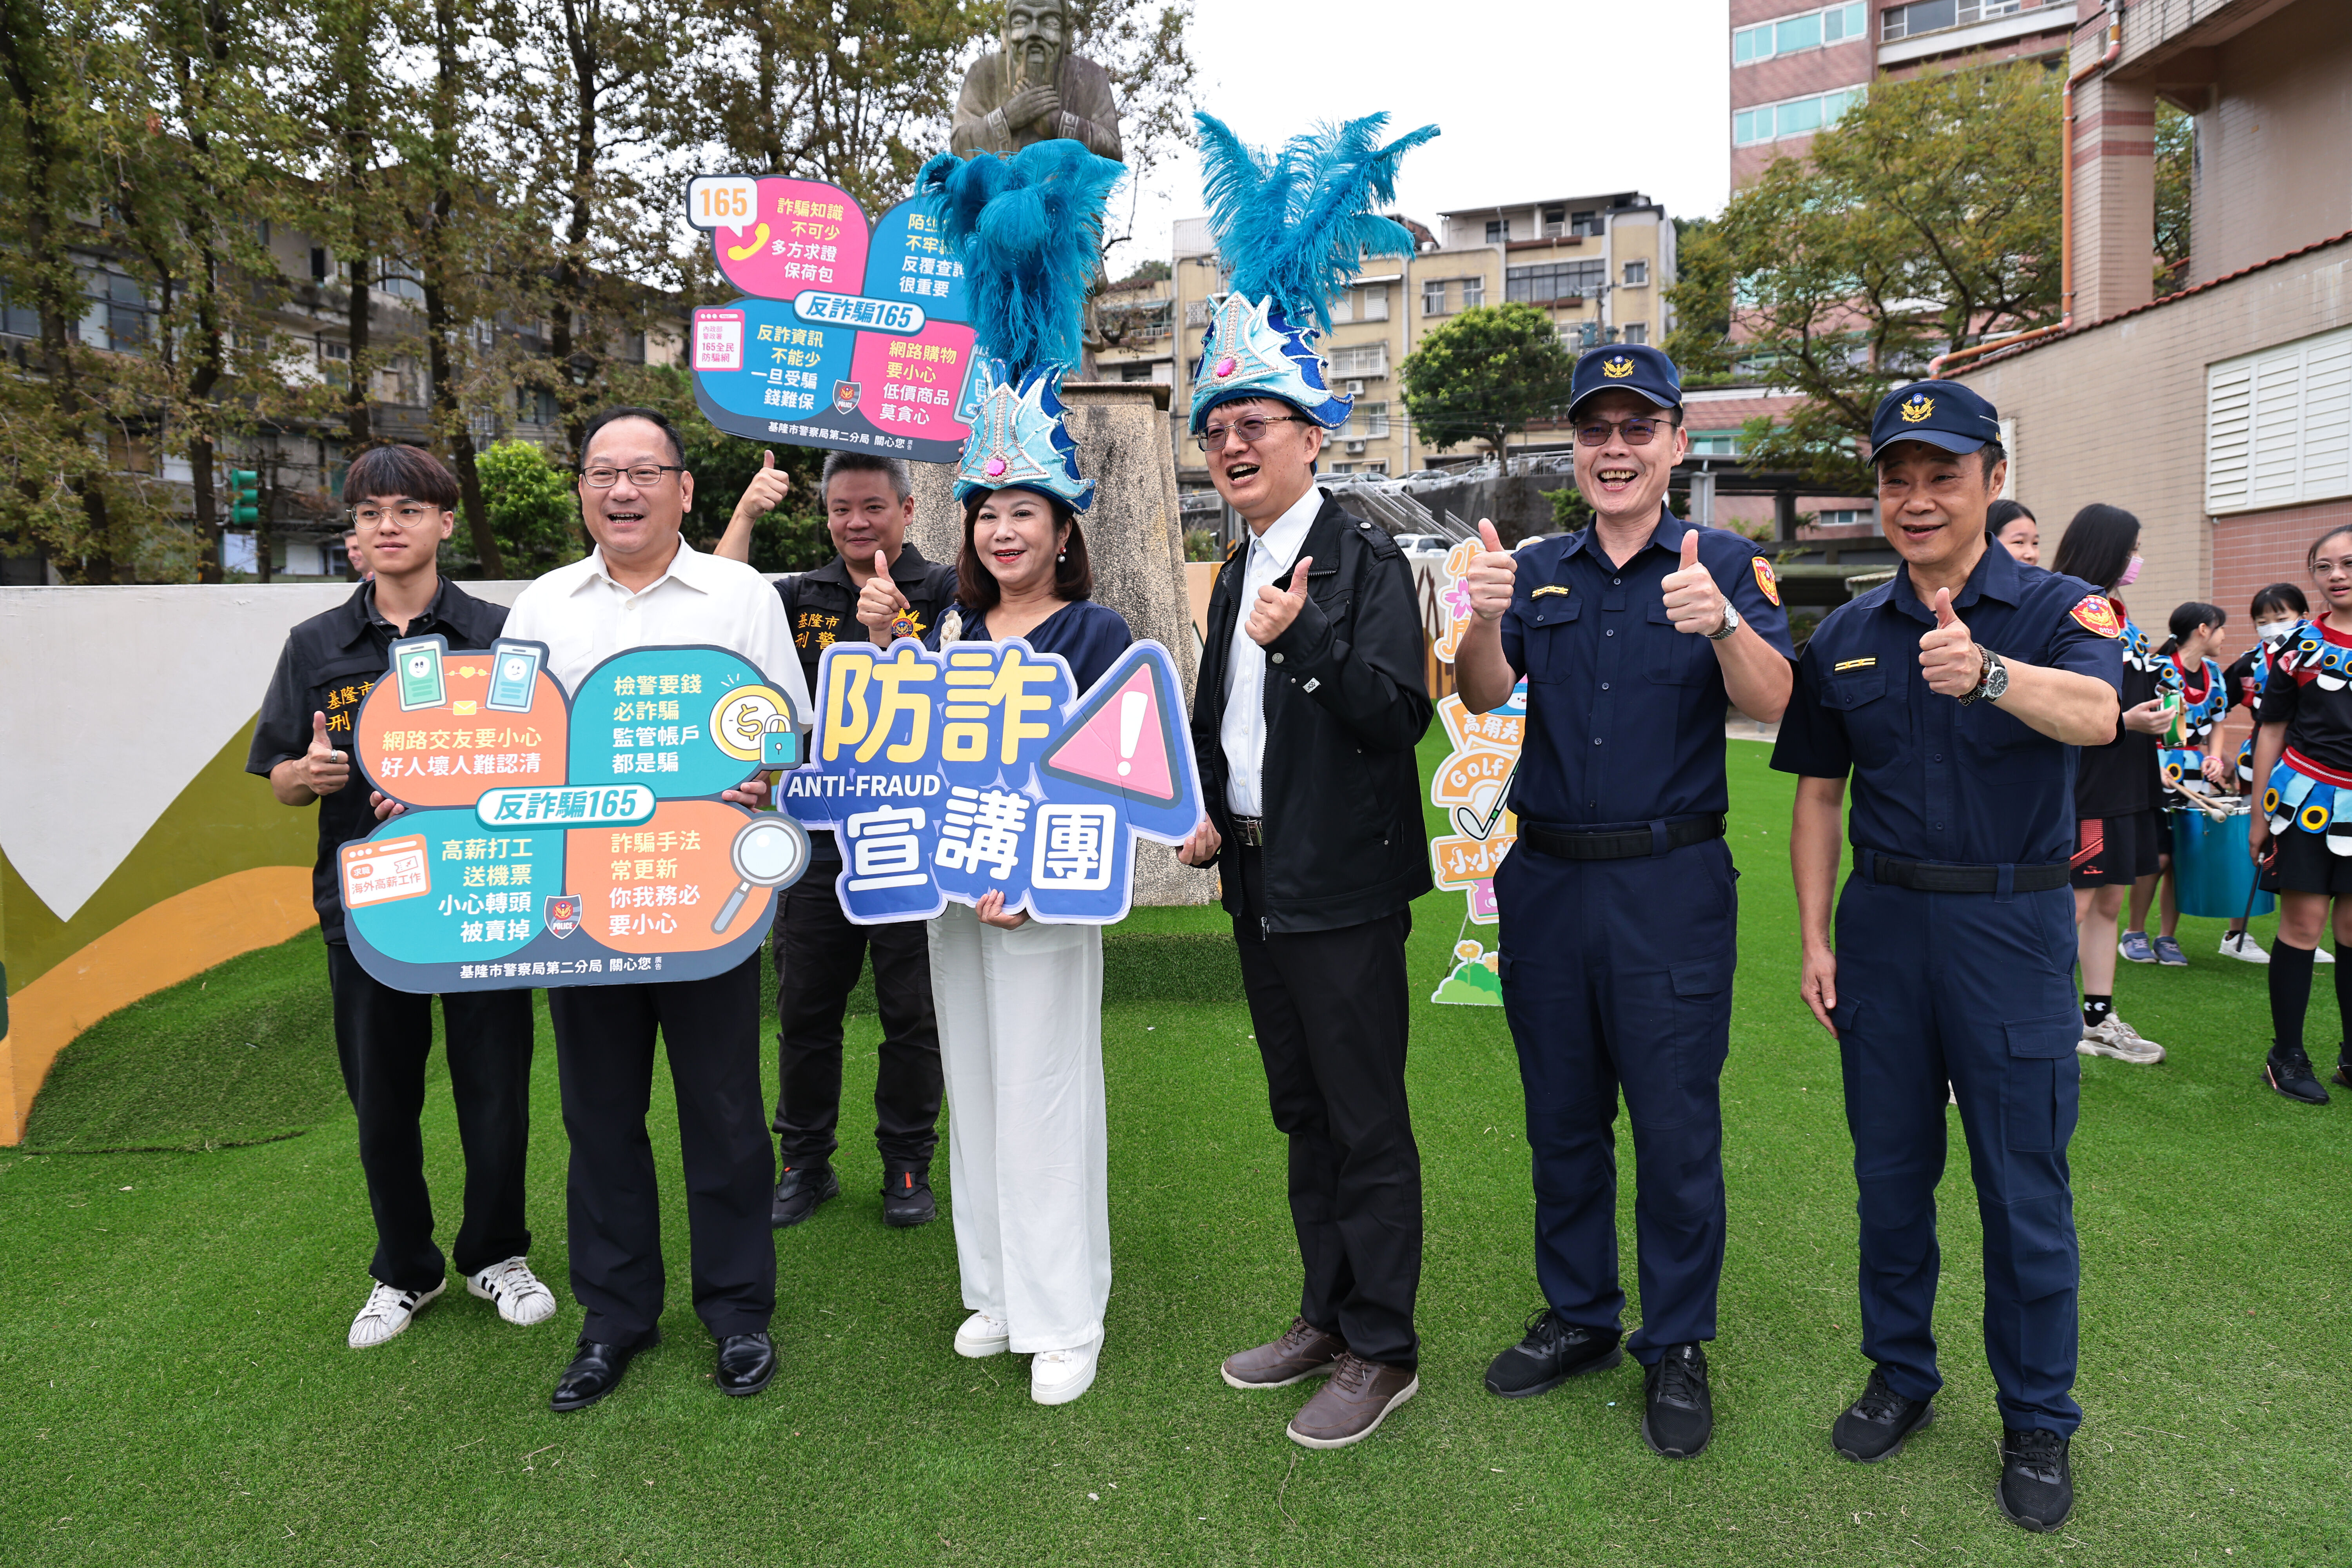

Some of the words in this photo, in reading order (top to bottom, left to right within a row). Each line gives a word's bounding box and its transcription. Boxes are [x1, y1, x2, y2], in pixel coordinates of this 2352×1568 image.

[700, 188, 747, 216] 165
[777, 198, 844, 221] 詐騙知識
[791, 221, 840, 241] 不可少
[771, 240, 837, 262] 多方求證
[784, 263, 833, 283] 保荷包
[899, 276, 949, 298] 很重要
[806, 295, 913, 329] 反詐騙165
[702, 343, 734, 352] 165全民
[757, 324, 824, 348] 反詐資訊
[702, 353, 730, 362] 防騙網
[771, 347, 821, 368] 不能少
[889, 341, 957, 365] 網路購物
[750, 370, 818, 390] 一旦受騙
[886, 361, 936, 383] 要小心
[764, 388, 815, 411] 錢難保
[883, 382, 950, 406] 低價商品
[879, 403, 930, 425] 莫貪心
[768, 421, 869, 445] 基隆市警察局第二分局
[874, 435, 905, 448] 關心您
[797, 612, 840, 630] 基隆市
[613, 673, 702, 697] 檢警要錢
[613, 701, 679, 721] 必詐騙
[822, 649, 1057, 764] 防詐
[612, 726, 699, 748] 監管帳戶
[1463, 711, 1519, 742] 高爾夫
[382, 727, 542, 752] 網路交友要小心
[381, 753, 541, 778] 好人壞人難認清
[612, 752, 679, 774] 都是騙
[787, 774, 940, 797] ANTI-FRAUD
[494, 789, 637, 821] 反詐騙165
[441, 839, 532, 861] 高薪打工
[611, 830, 701, 854] 詐騙手法
[848, 786, 1116, 892] 宣講團
[354, 866, 370, 876] 求職
[463, 864, 532, 887] 送機票
[611, 858, 677, 881] 常更新
[352, 872, 421, 894] 海外高薪工作
[438, 892, 532, 916] 小心轉頭
[609, 884, 700, 909] 你我務必
[460, 919, 530, 943] 被賣掉
[553, 922, 573, 930] POLICE
[609, 913, 677, 936] 要小心
[460, 959, 602, 979] 基隆市警察局第二分局
[610, 957, 651, 972] 關心您
[655, 956, 662, 971] 廣告
